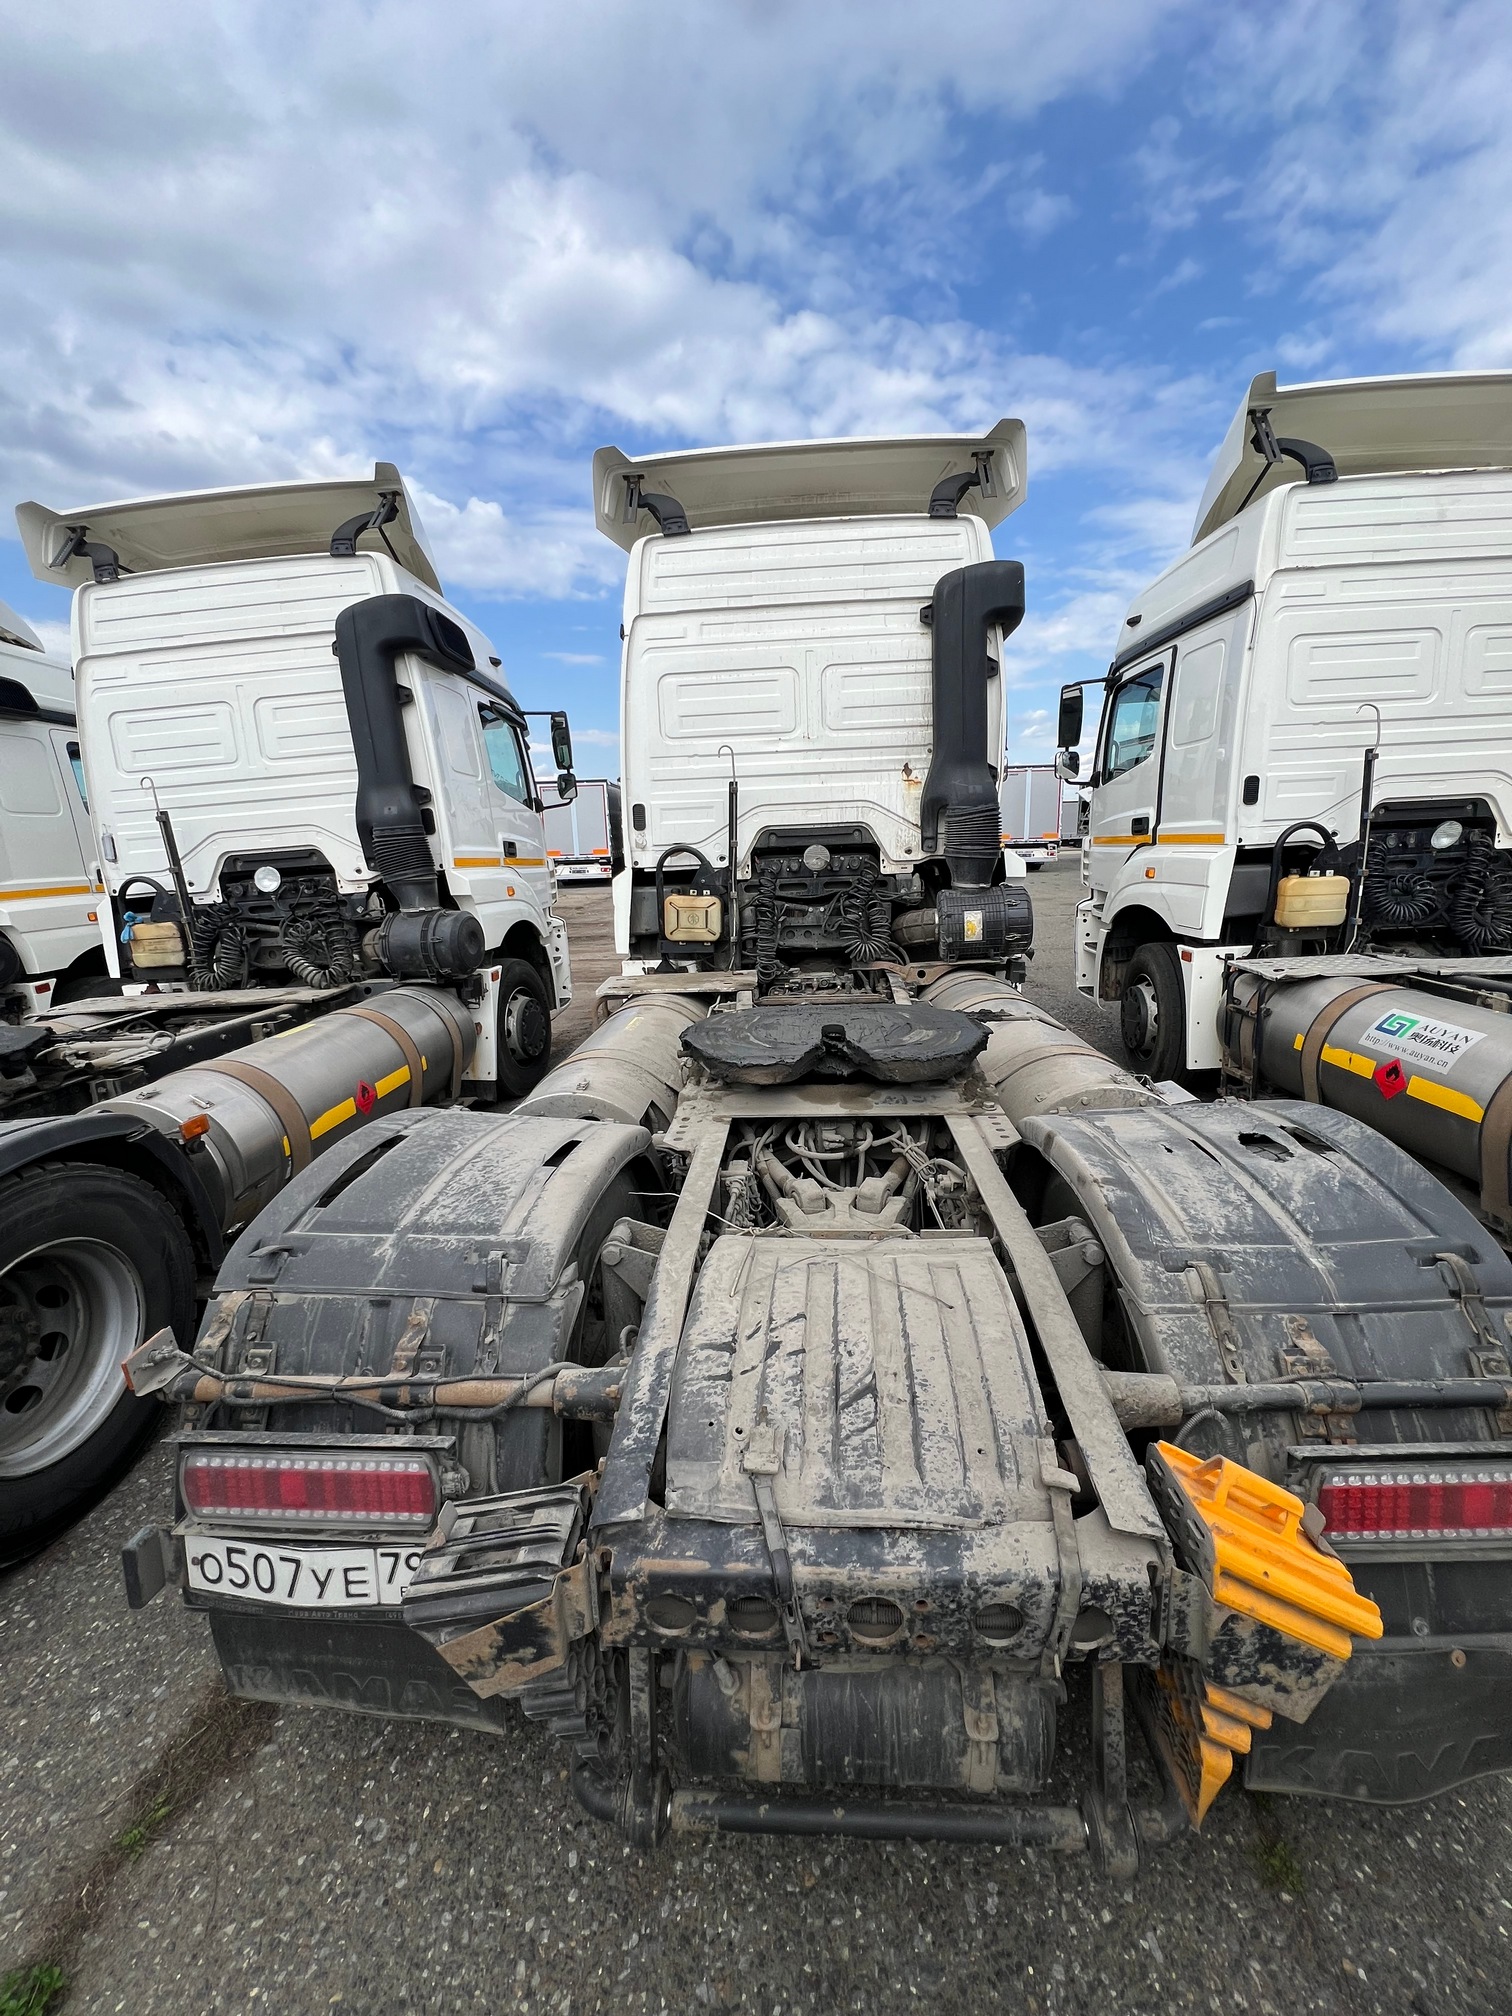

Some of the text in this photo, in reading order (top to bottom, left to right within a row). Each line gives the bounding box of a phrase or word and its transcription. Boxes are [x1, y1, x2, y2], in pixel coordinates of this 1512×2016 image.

[1407, 1031, 1462, 1055] 奥扬科技
[1419, 1024, 1474, 1044] AUYAN
[1364, 1033, 1449, 1068] http://www.auyan.cn
